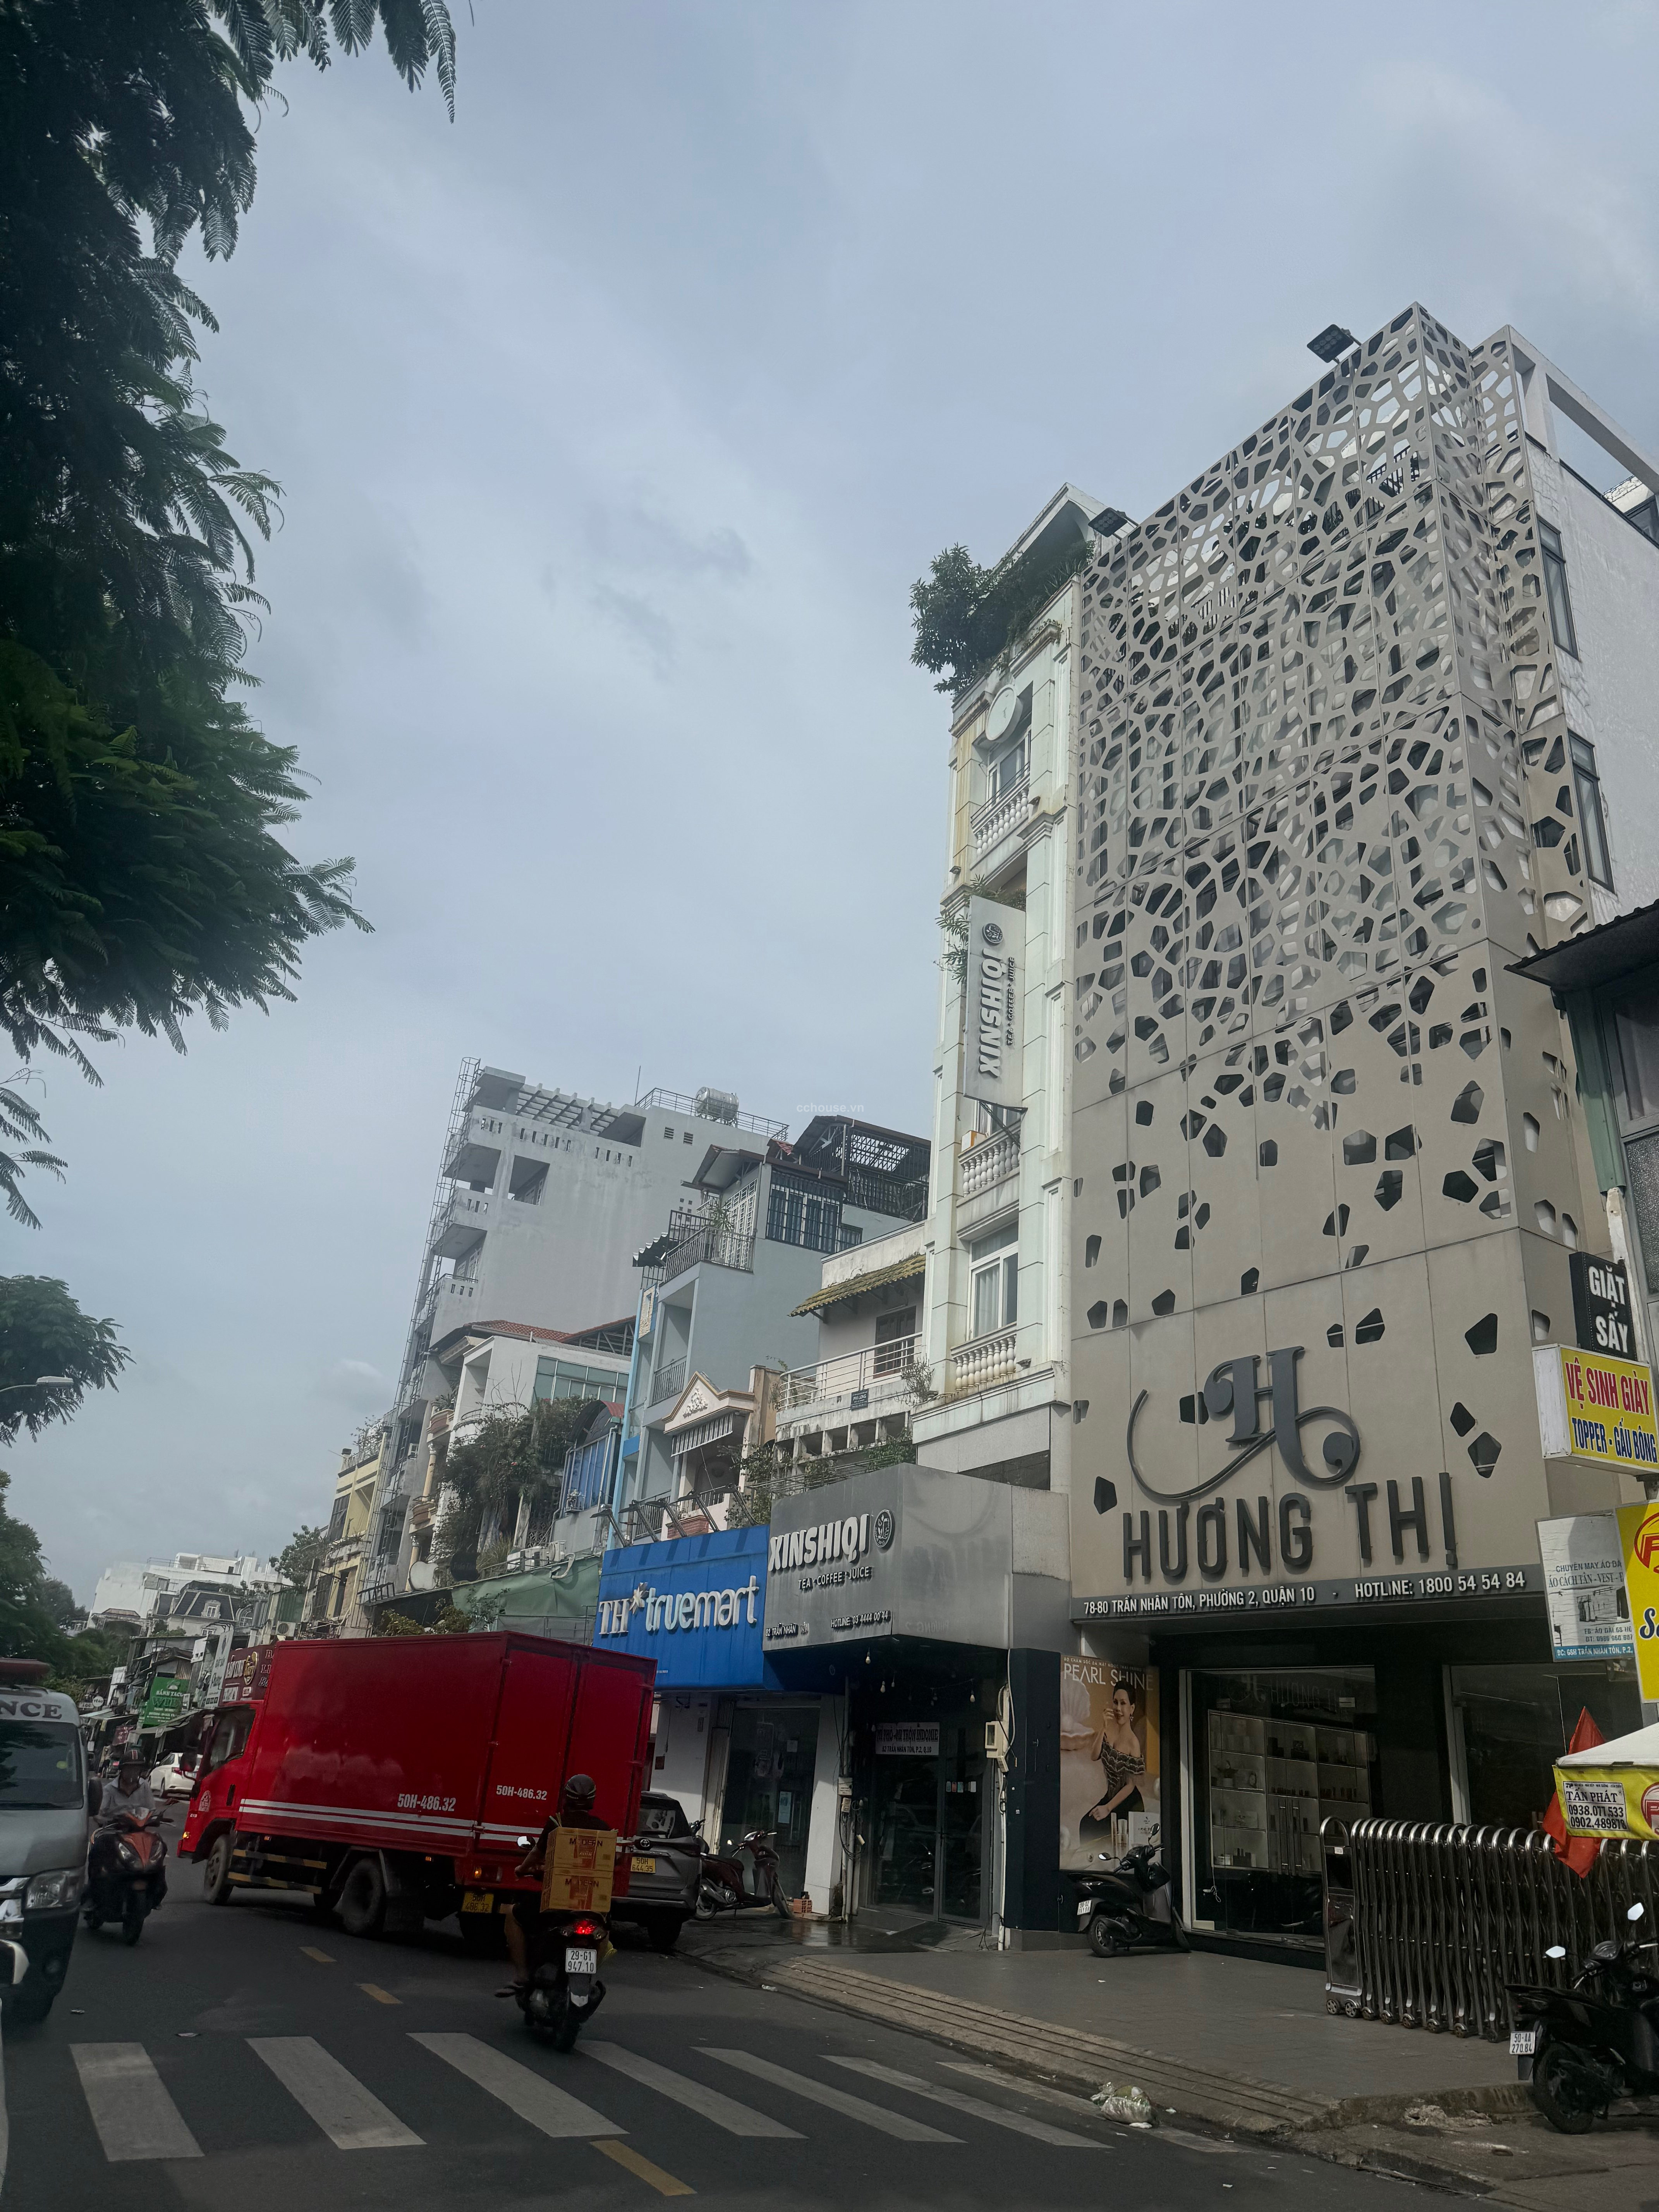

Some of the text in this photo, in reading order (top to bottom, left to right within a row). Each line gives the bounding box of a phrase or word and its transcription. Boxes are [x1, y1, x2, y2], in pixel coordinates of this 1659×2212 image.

[979, 948, 1006, 1077] XINSHIQI
[1589, 1265, 1625, 1308] GIẶT
[1596, 1311, 1628, 1353] SẤY
[1565, 1357, 1650, 1416] VỆ SINH GIÀY
[1572, 1417, 1658, 1464] TOPPER GẤU BÔNG
[1123, 1472, 1456, 1580] HƯƠNG THỊ
[768, 1514, 869, 1571] XINSHIQI
[799, 1566, 869, 1589] TEA COFFEE JUICE
[1549, 1575, 1558, 1588] ÁO
[1559, 1573, 1577, 1587] CÁCH
[1578, 1572, 1592, 1585] TÂN
[1597, 1573, 1614, 1583] VEST
[1084, 1571, 1525, 1614] 78-80 TRẦN NHÂN TÔN, PHƯỜNG 2, QUẬN 10 HOTLINE: 1800 54 54 84
[598, 1599, 629, 1634] TH
[831, 1611, 888, 1627] HOTLINE: 03 4444 00 44
[1064, 1663, 1153, 1690] PEARL SHINE
[397, 1794, 456, 1812] 50H-486.32
[496, 1785, 547, 1800] 50H-486.32
[1590, 1790, 1618, 1803] PHÁT
[1569, 1805, 1623, 1817] 0938.077.533
[1571, 1817, 1627, 1829] 0902.489878
[568, 1961, 594, 1972] 947.10
[571, 1950, 591, 1961] 29-G1
[1512, 2043, 1532, 2053] 270.84
